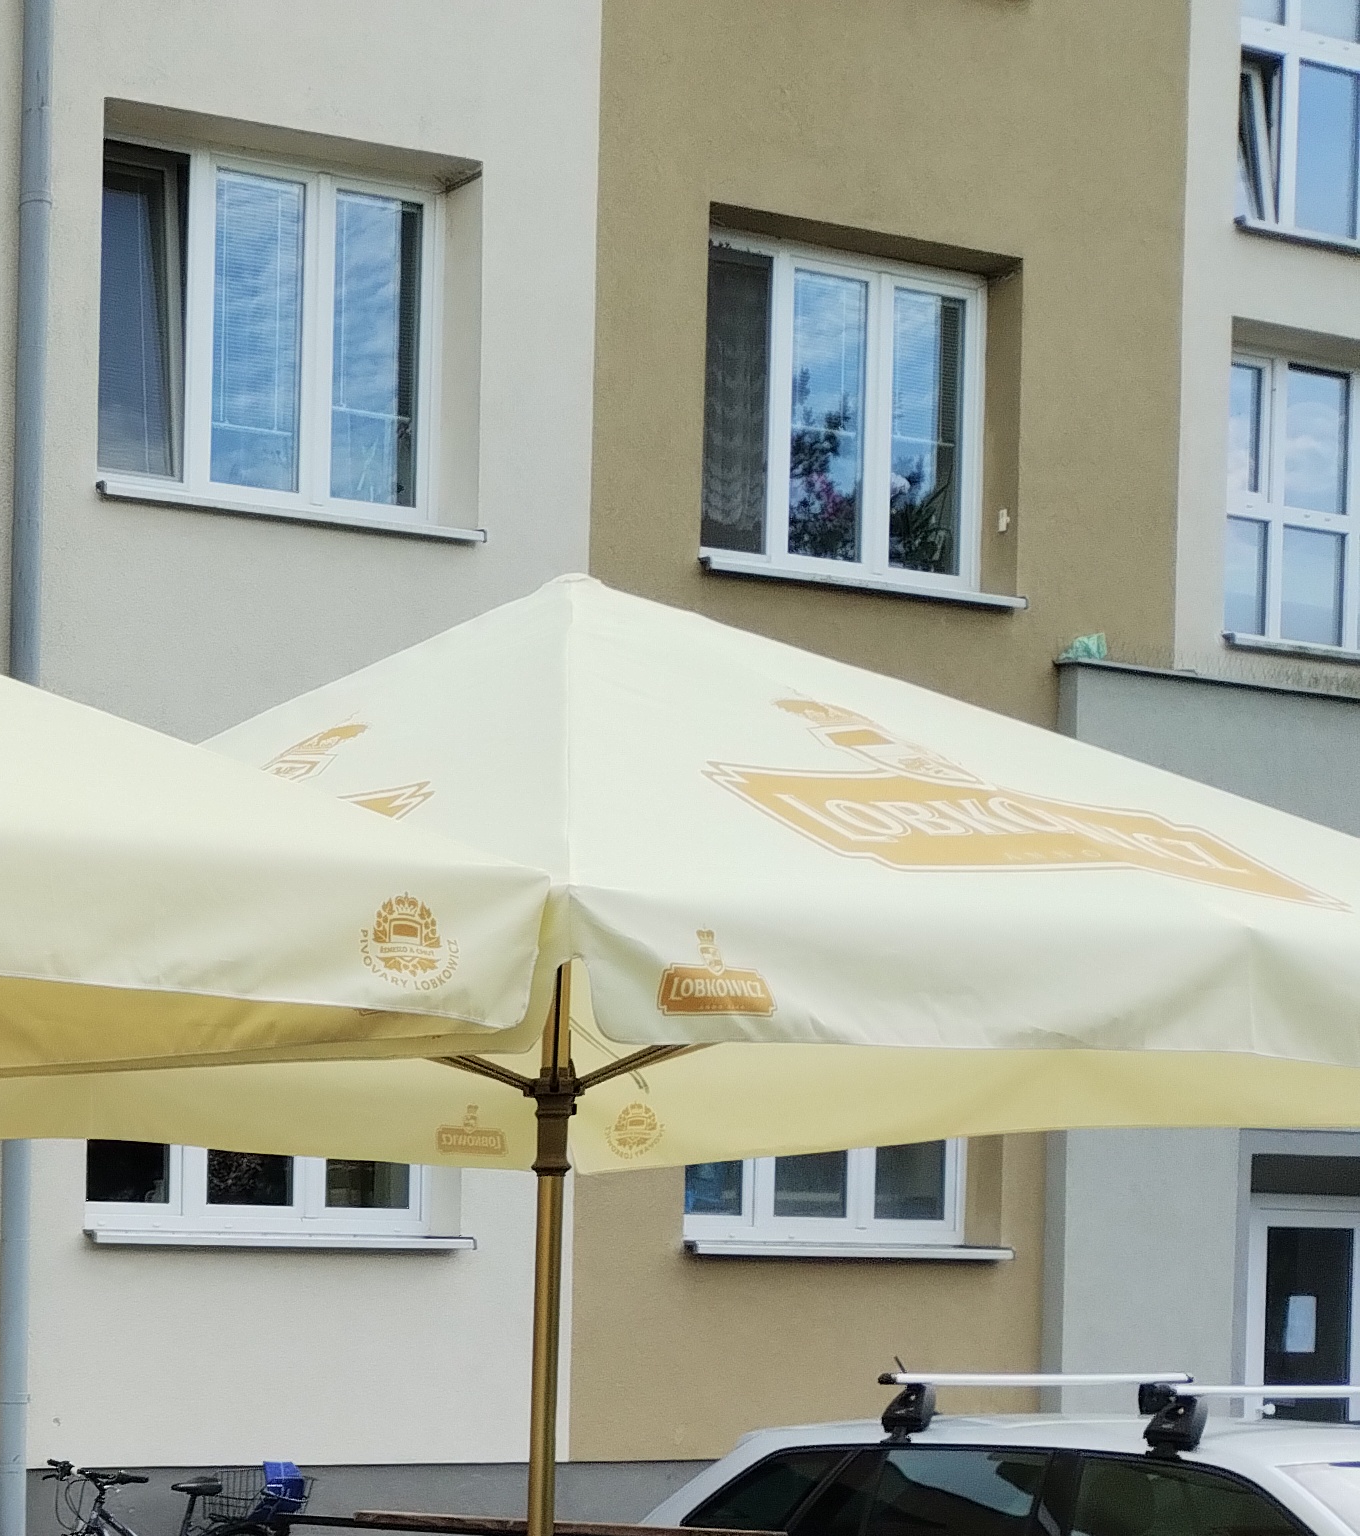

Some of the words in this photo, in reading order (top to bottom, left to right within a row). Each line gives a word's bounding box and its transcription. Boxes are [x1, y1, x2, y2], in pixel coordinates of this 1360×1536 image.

[359, 928, 409, 988] PIVOVARY
[413, 939, 461, 991] LOBKOWICZ
[669, 976, 766, 1000] LOBKOWICZ
